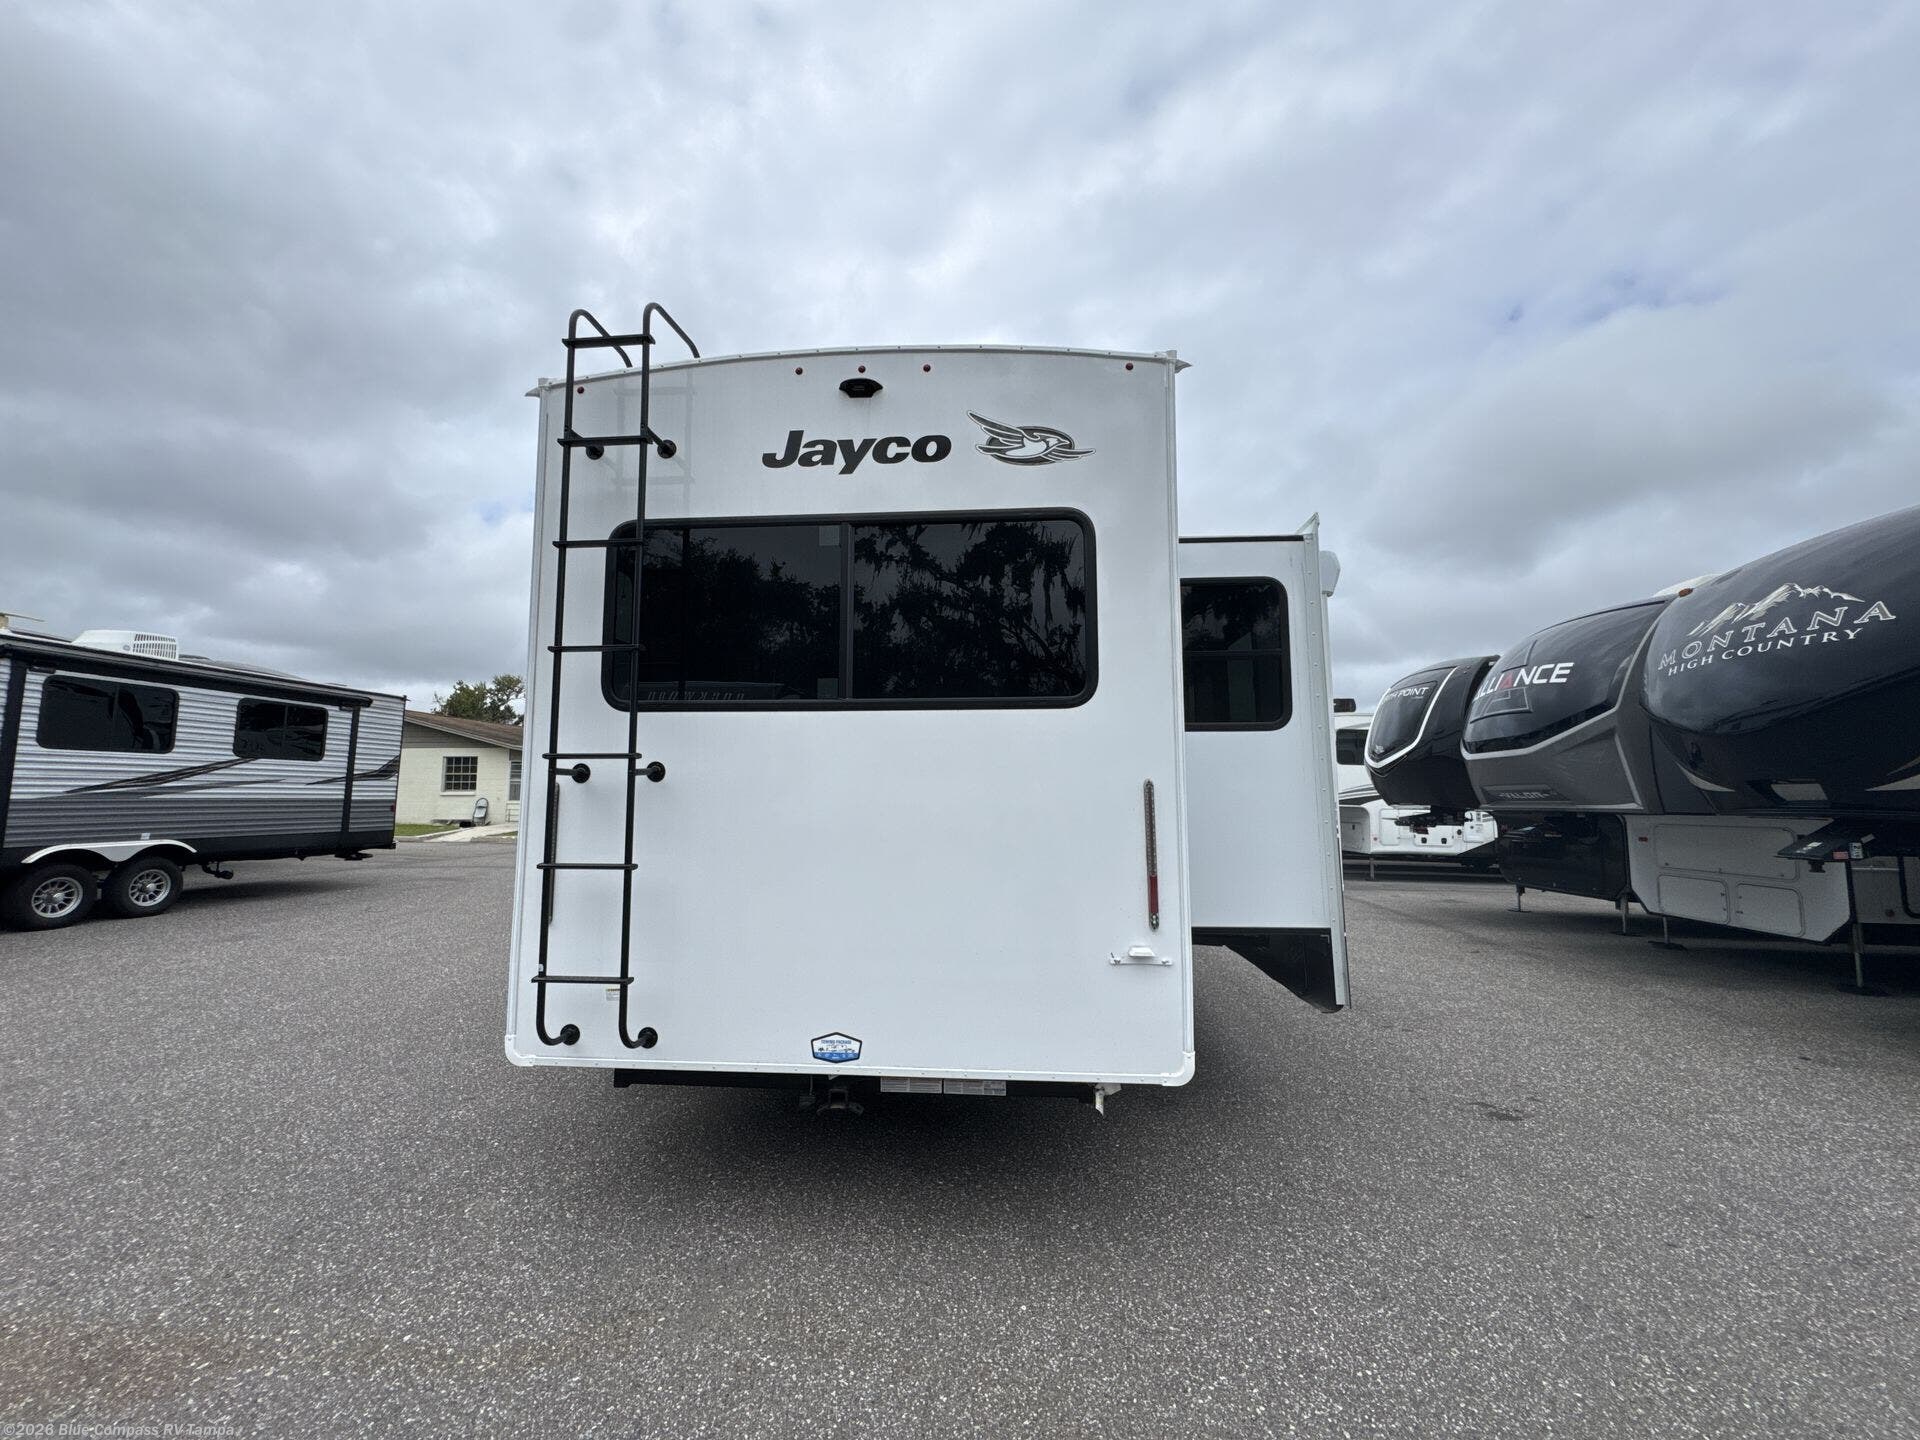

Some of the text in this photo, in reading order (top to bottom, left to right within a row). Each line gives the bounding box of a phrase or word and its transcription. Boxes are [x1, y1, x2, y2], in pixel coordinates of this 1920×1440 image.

[762, 430, 952, 475] Jayco
[1657, 601, 1896, 670] MONTANA
[1668, 627, 1864, 676] HIGH COUNTRY
